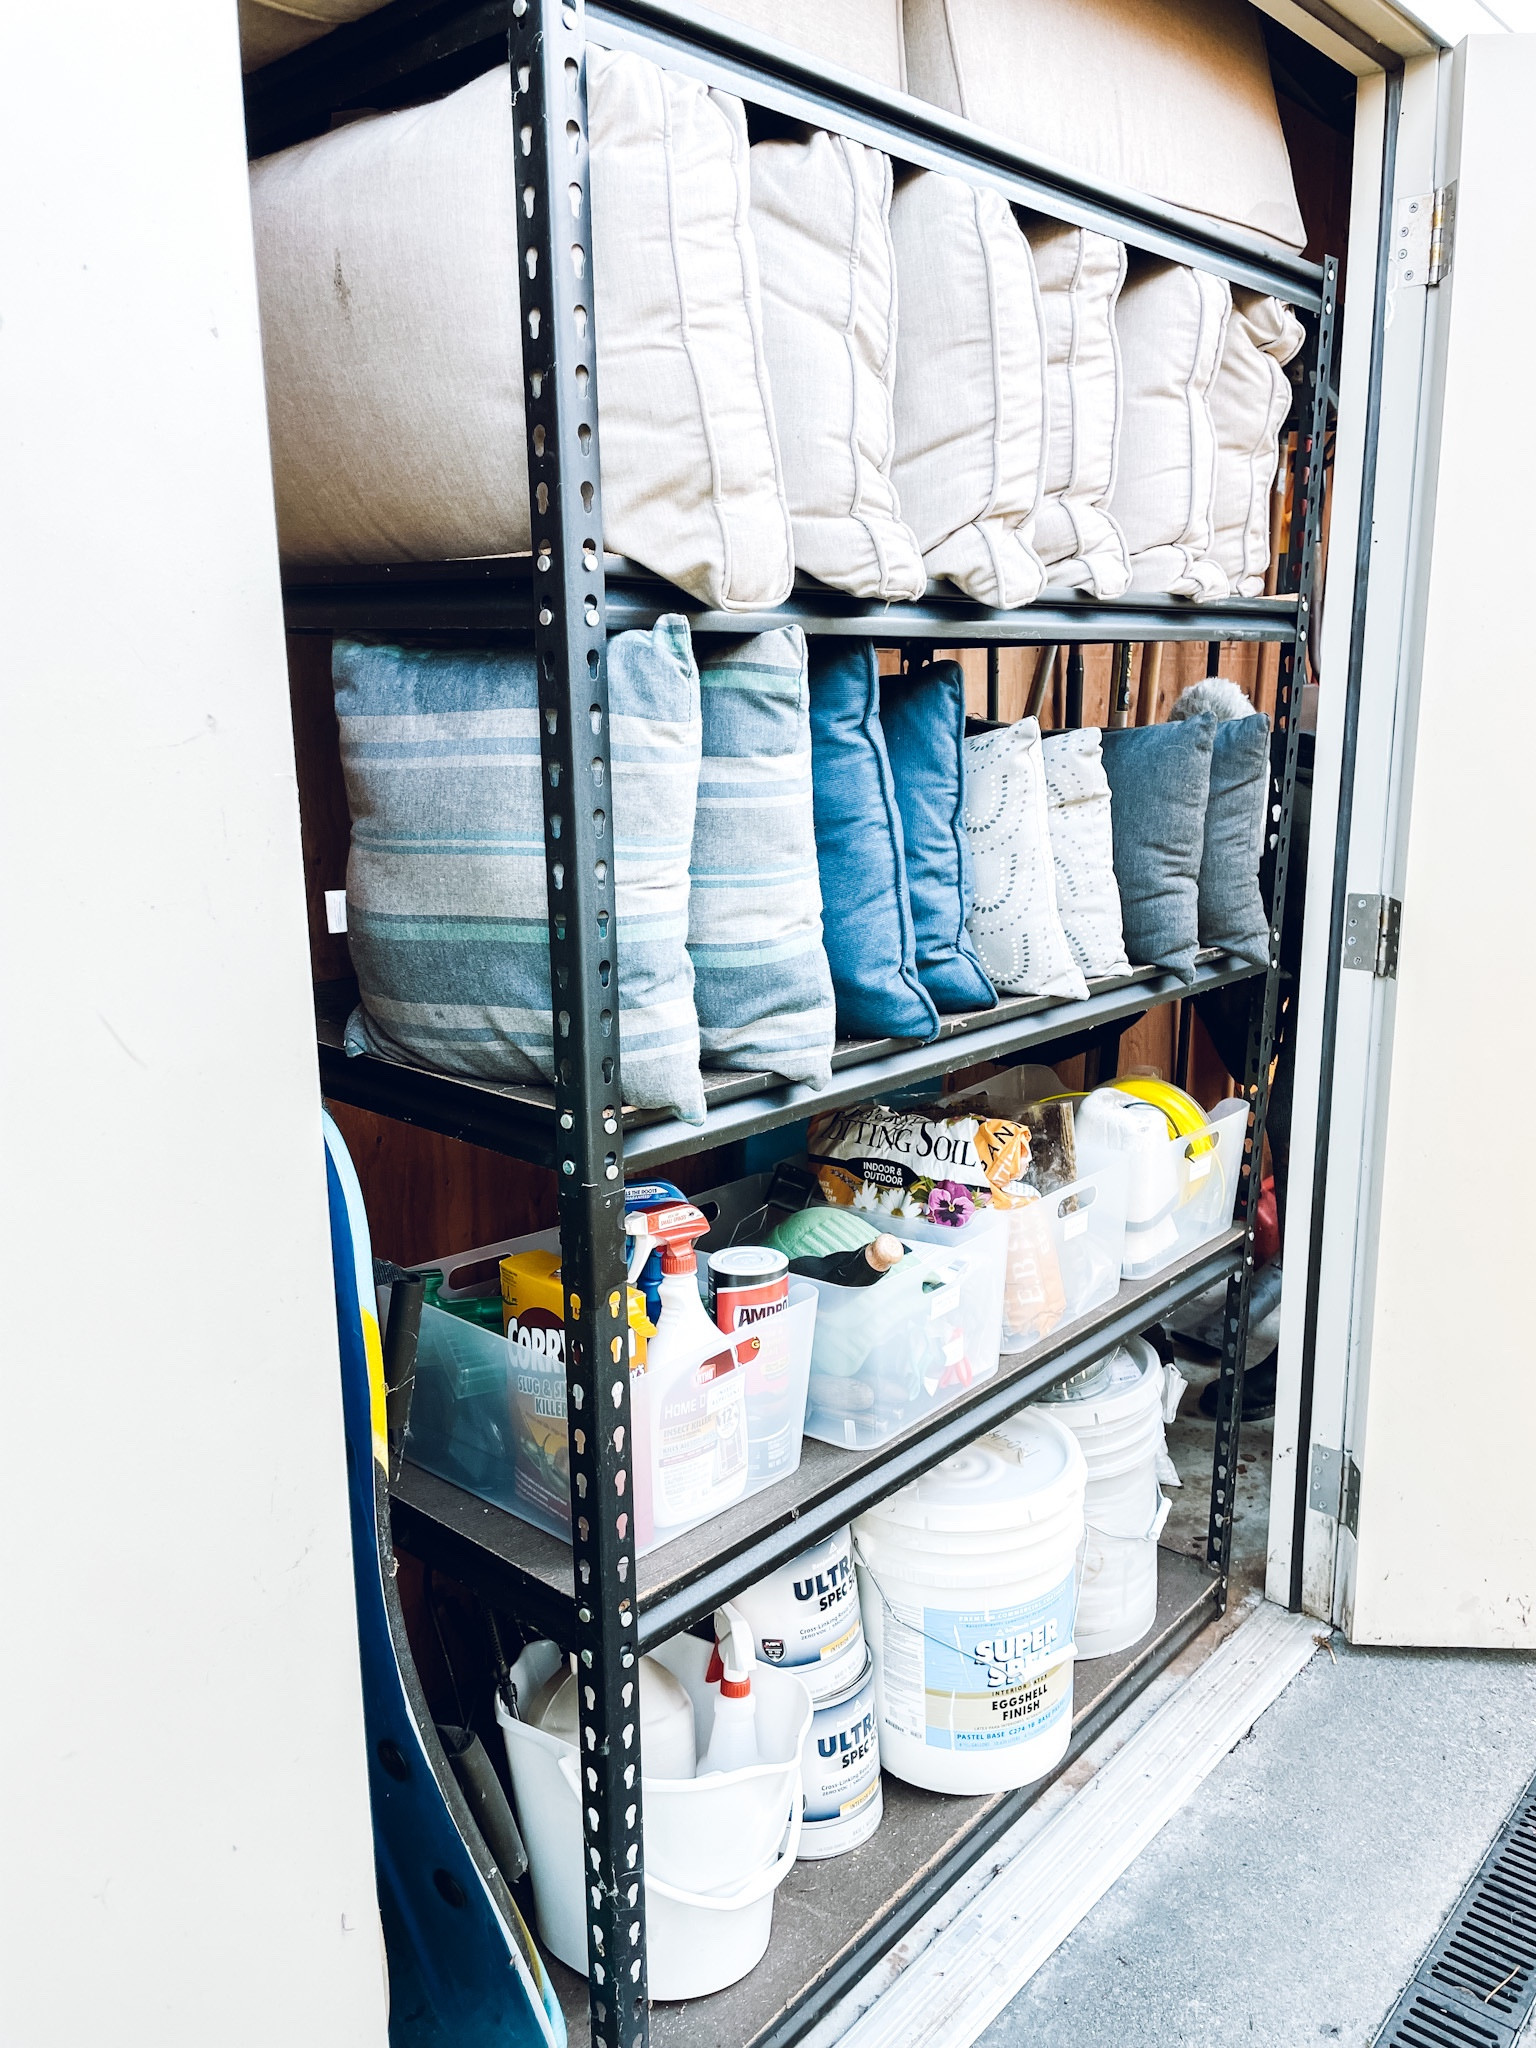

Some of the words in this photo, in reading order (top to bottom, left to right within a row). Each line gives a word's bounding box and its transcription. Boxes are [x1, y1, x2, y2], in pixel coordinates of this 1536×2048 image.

[916, 1121, 977, 1167] SOIL
[863, 1161, 896, 1175] INDOOR
[896, 1167, 903, 1176] &
[863, 1171, 903, 1186] OUTDOOR
[518, 1374, 540, 1396] SLUG
[542, 1380, 553, 1398] &
[664, 1400, 697, 1420] HOME
[663, 1421, 690, 1438] INSECT
[819, 1582, 848, 1612] SPEC
[974, 1618, 1058, 1663] SUPER
[987, 1648, 1052, 1688] SP
[991, 1684, 1027, 1697] INTERIOR
[1032, 1673, 1048, 1685] ATEX
[991, 1684, 1049, 1711] EGGSHELL
[1002, 1699, 1041, 1721] FINISH
[957, 1732, 985, 1740] PASTEL
[986, 1730, 1005, 1740] BASE
[842, 1739, 869, 1769] SPEC
